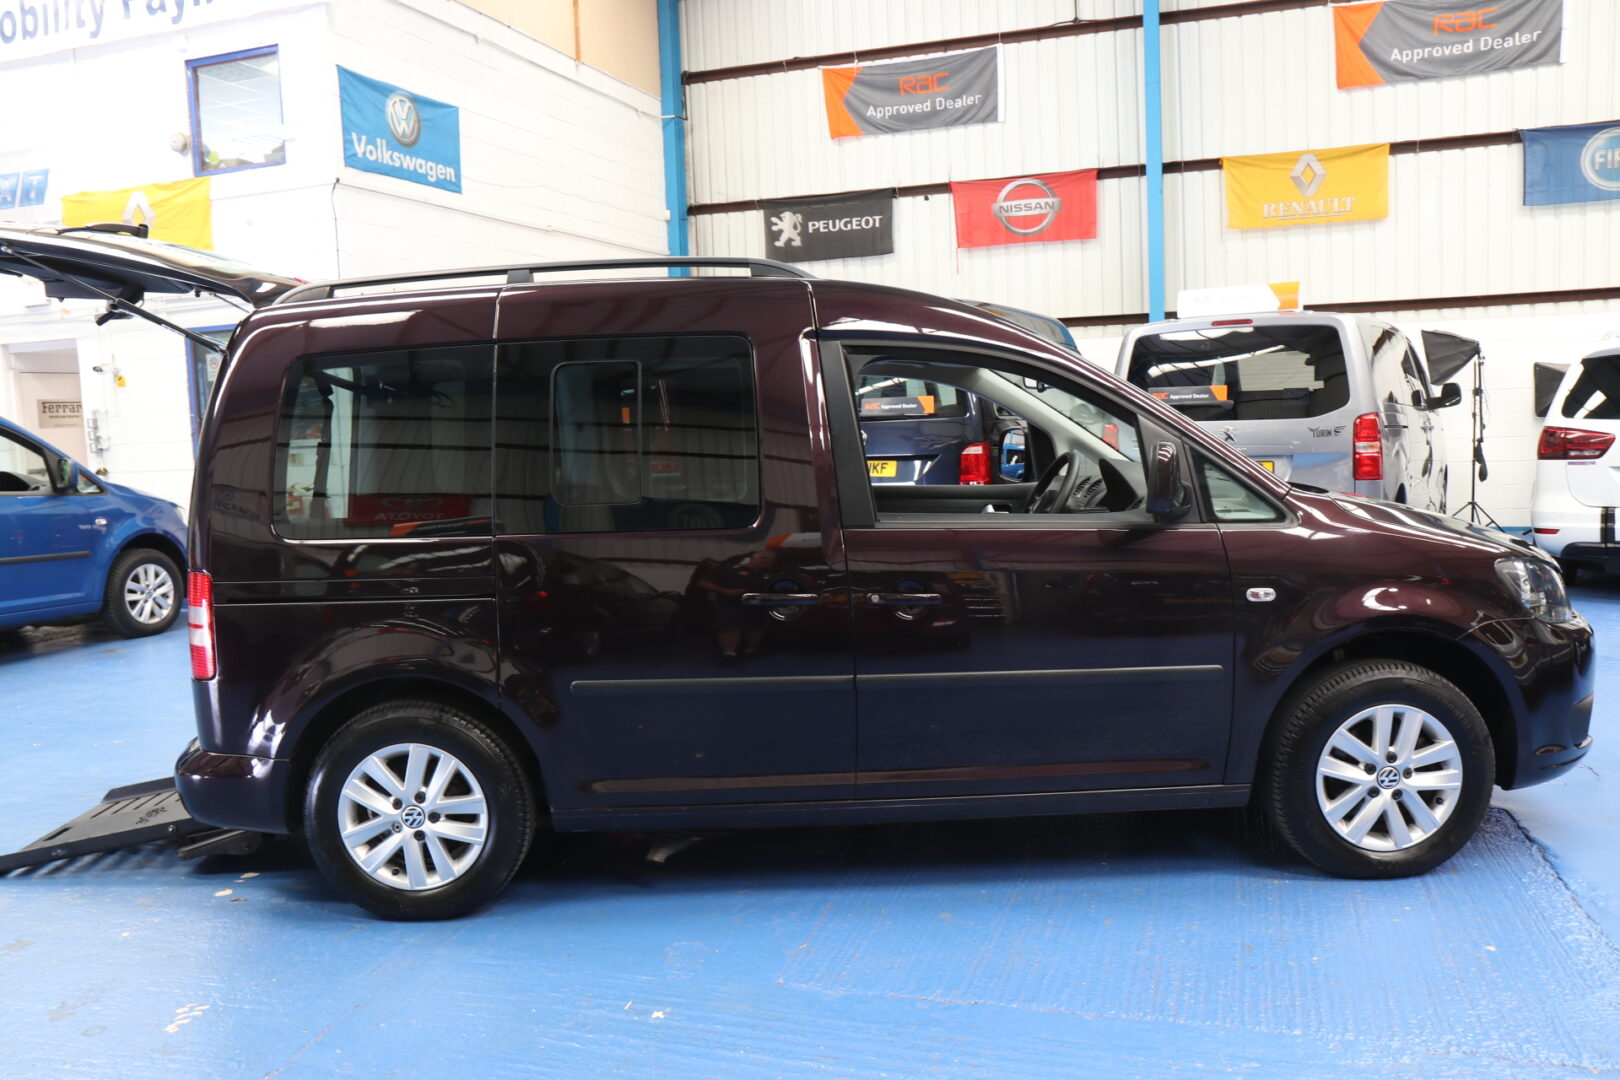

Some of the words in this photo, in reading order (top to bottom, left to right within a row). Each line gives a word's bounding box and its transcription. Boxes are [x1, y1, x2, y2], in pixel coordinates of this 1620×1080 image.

[1390, 38, 1474, 63] Approved
[1479, 29, 1543, 50] Dealer
[866, 99, 931, 119] Approved
[936, 92, 982, 111] Dealer
[351, 131, 456, 182] Volkswagen
[998, 200, 1055, 215] NISSAN
[1263, 197, 1355, 218] RENAULT
[808, 215, 883, 233] PEUGEOT
